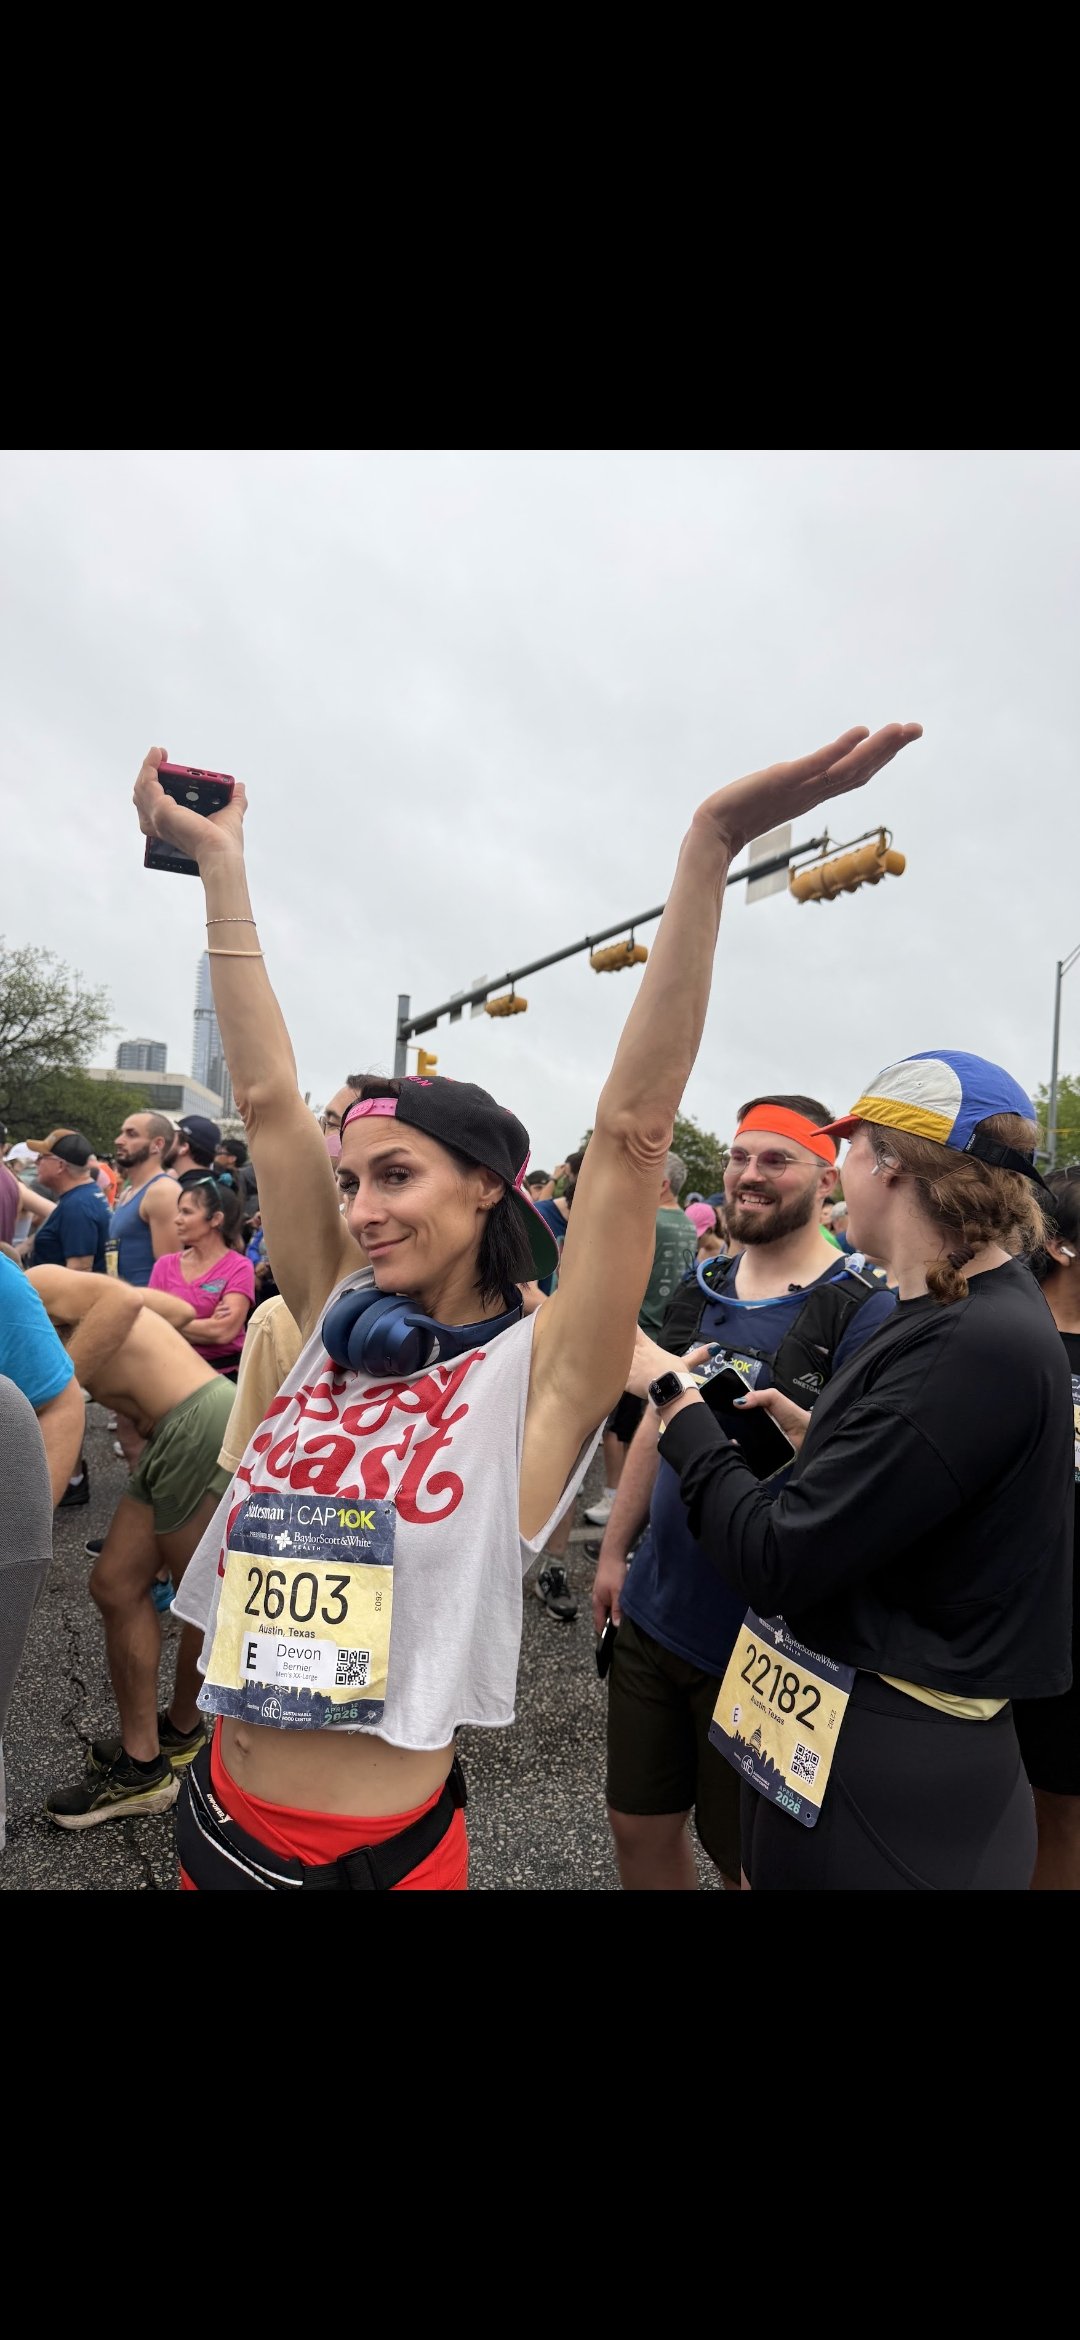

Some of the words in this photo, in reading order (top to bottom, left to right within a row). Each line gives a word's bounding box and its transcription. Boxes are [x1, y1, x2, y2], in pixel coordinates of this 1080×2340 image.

[297, 1505, 376, 1530] CAP10K
[293, 1532, 371, 1548] BaylorScott&White
[244, 1567, 351, 1625] 2603
[374, 1591, 382, 1612] 2603
[258, 1624, 286, 1637] Austin,
[288, 1627, 316, 1639] Texas
[246, 1642, 258, 1670] E
[276, 1644, 321, 1660] Devon
[282, 1662, 312, 1672] Bernier
[740, 1644, 822, 1731] 22182
[263, 1701, 280, 1719] sfc
[324, 1708, 359, 1723] 2026
[733, 1707, 740, 1723] E
[750, 1695, 767, 1713] Austin,
[767, 1707, 786, 1726] Texas
[775, 1791, 801, 1815] 2026
